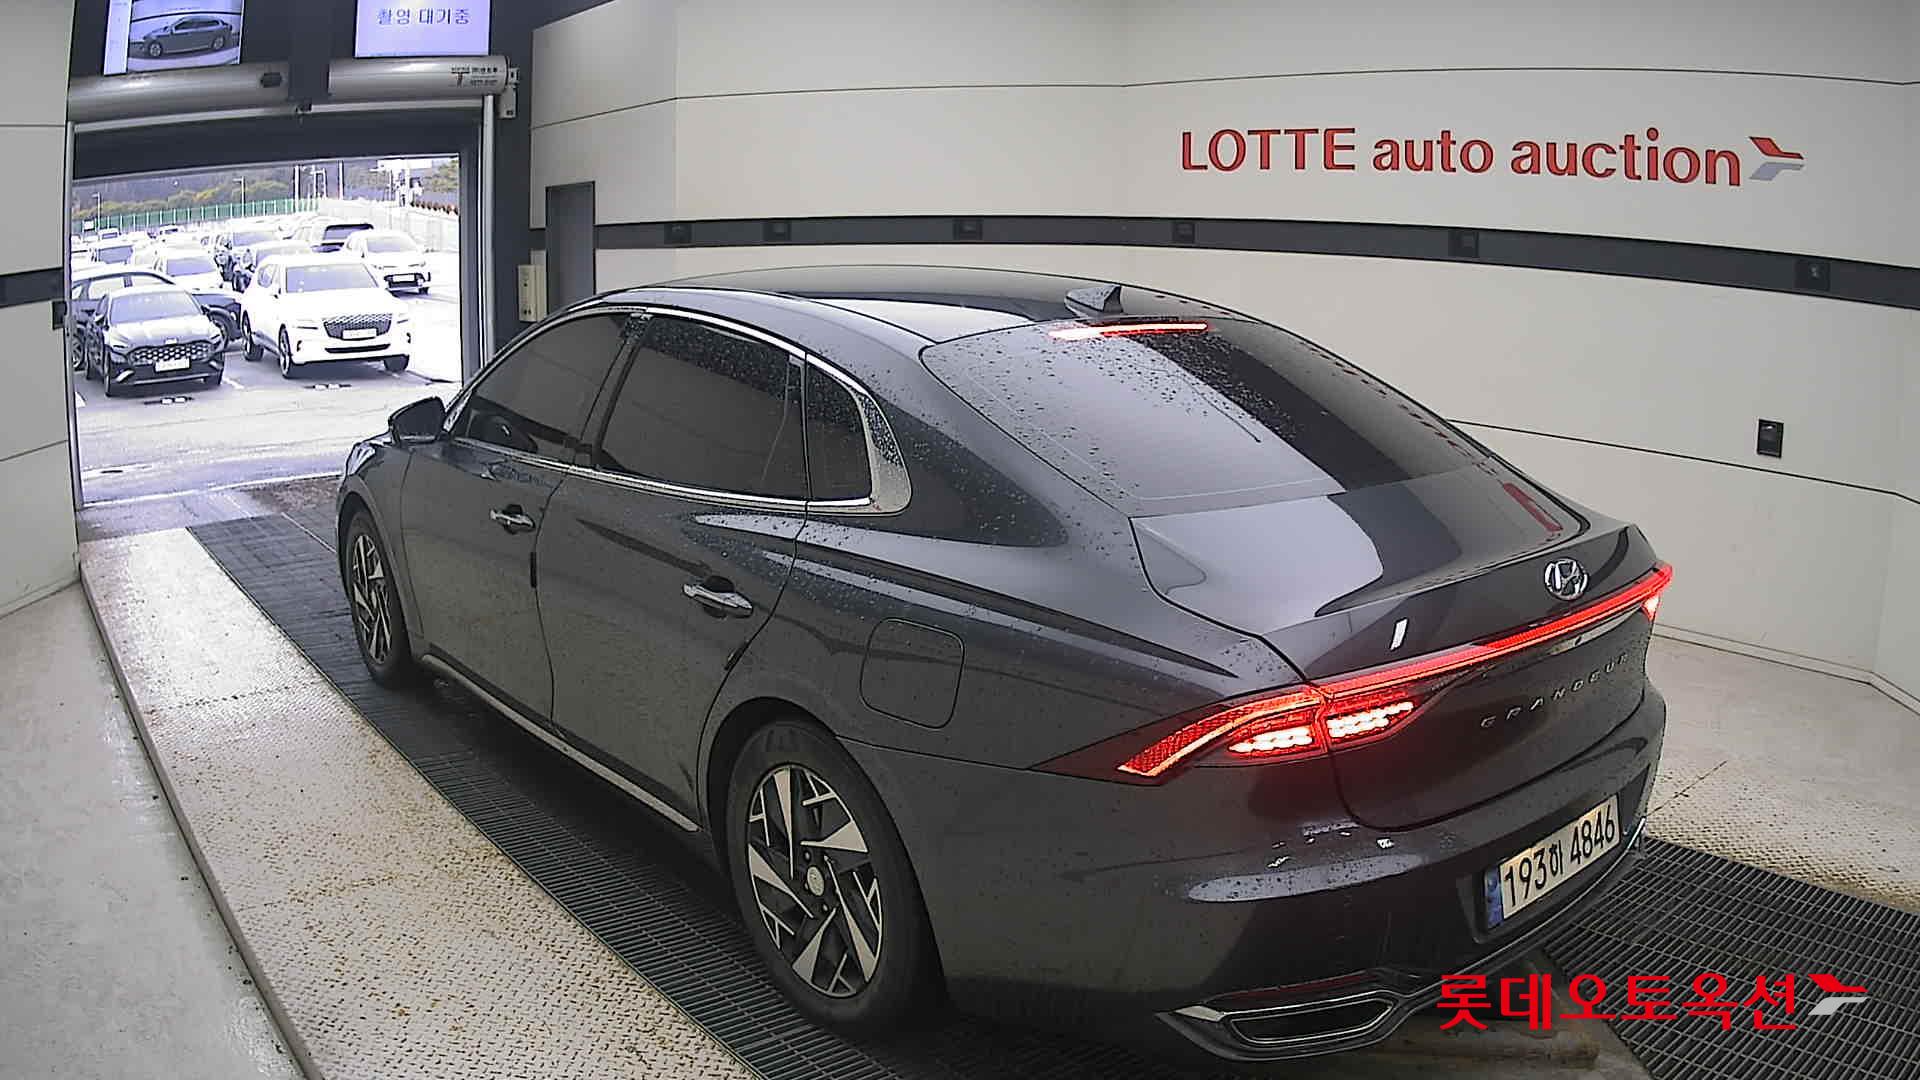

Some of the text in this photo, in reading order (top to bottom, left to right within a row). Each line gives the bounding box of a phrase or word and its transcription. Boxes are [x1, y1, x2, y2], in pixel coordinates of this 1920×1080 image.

[419, 7, 470, 25] 대기중
[1181, 127, 1742, 187] LOTTE auto auction
[1503, 803, 1615, 908] 193하 4846
